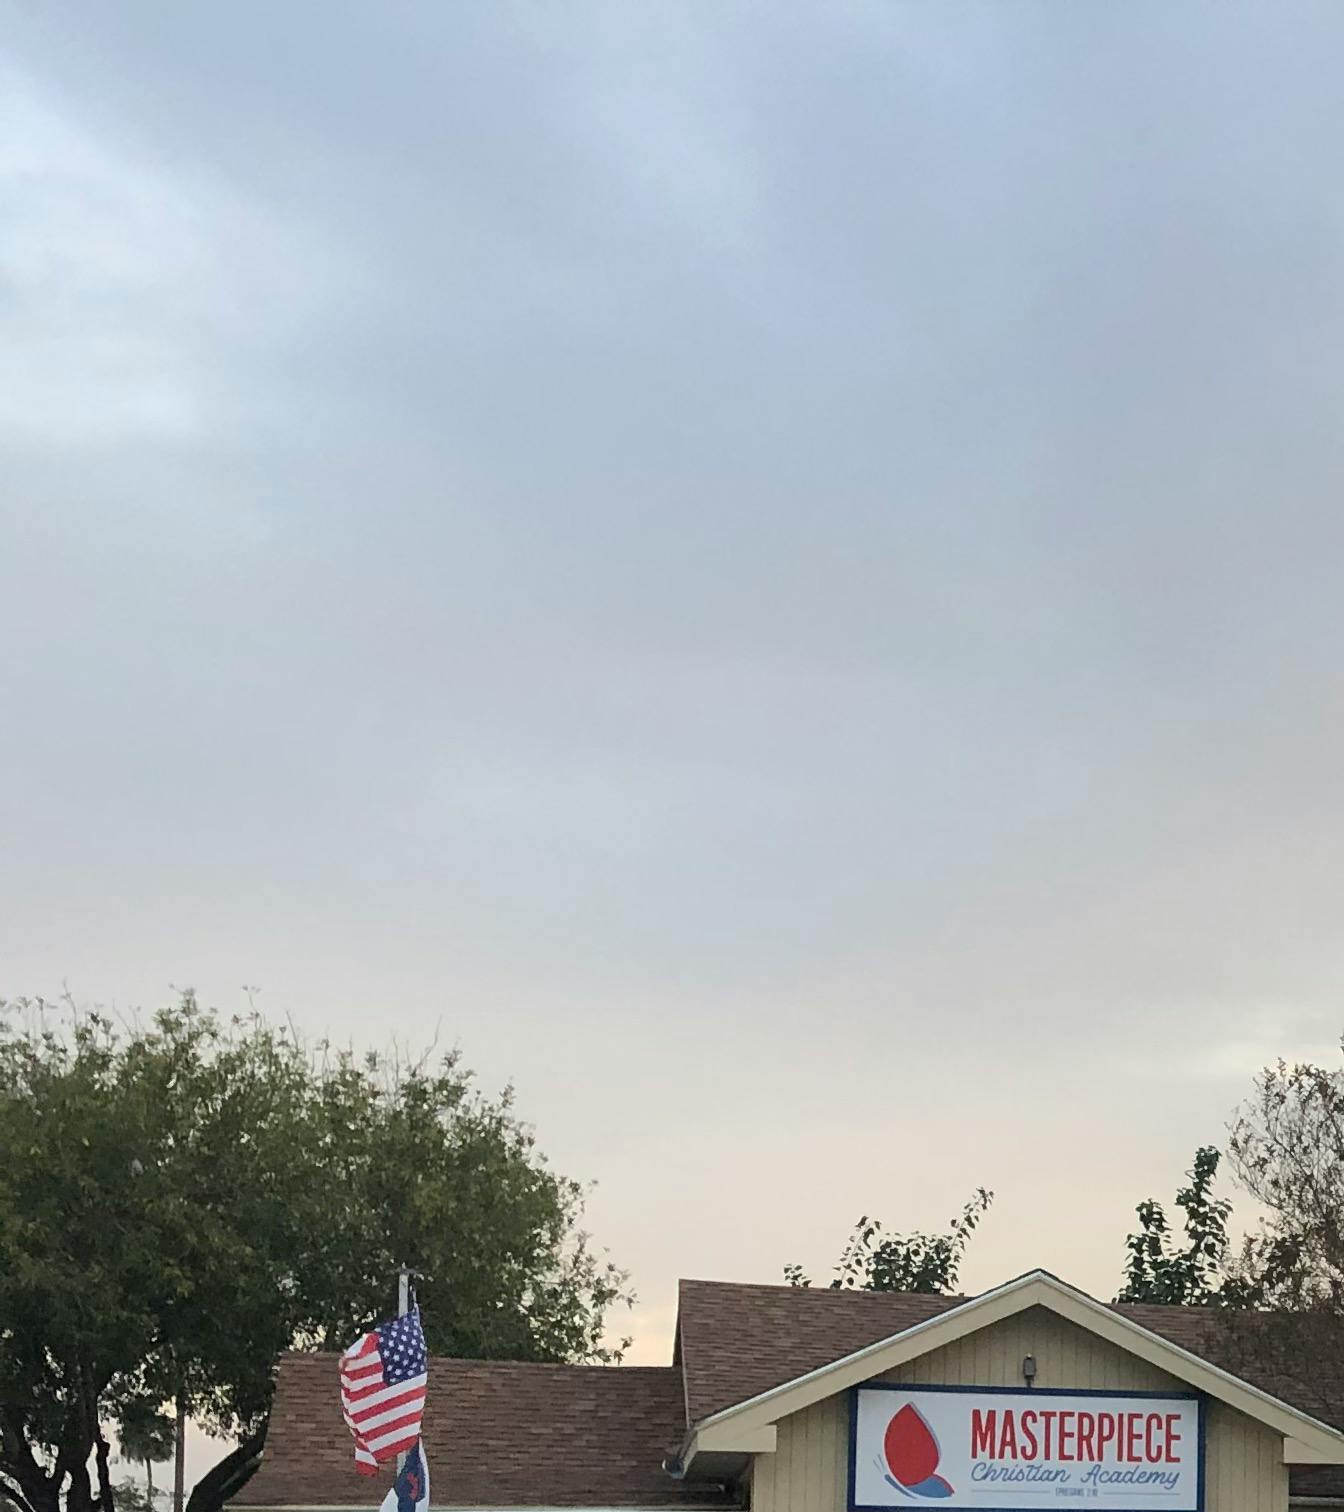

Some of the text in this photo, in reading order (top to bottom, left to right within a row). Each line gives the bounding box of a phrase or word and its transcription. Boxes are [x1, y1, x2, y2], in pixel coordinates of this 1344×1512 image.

[971, 1409, 1181, 1463] MASTERPIECE
[971, 1462, 1180, 1490] Christian Academy
